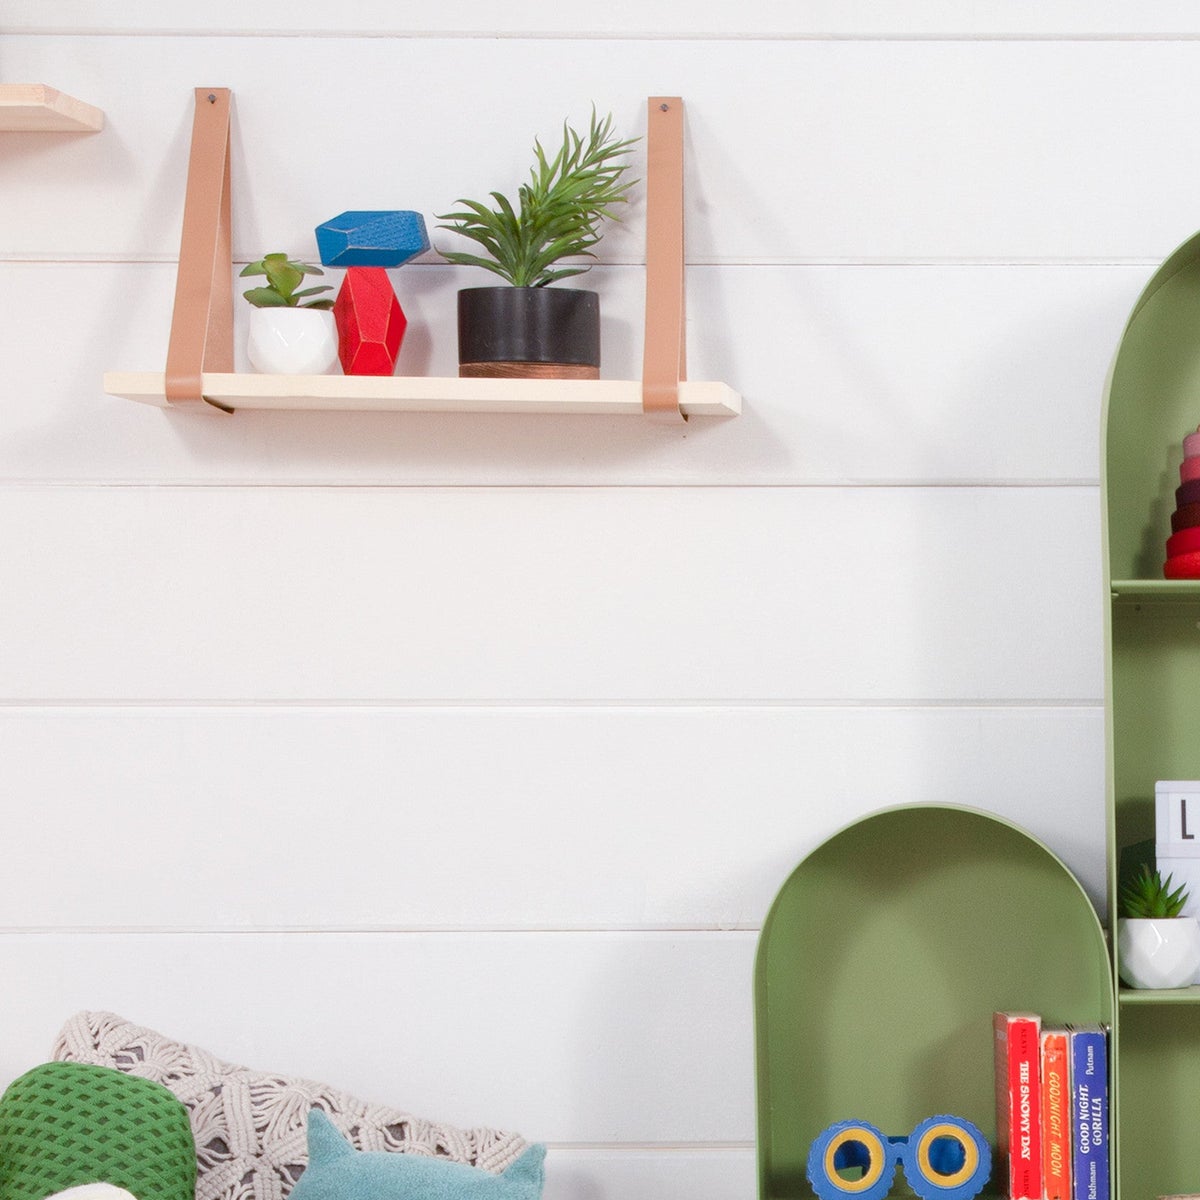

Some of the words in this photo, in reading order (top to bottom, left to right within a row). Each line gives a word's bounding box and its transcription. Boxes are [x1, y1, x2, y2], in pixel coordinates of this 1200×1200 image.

[1020, 1062, 1029, 1084] THE
[1085, 1046, 1094, 1075] Putnam
[1020, 1086, 1030, 1134] SNOWY
[1049, 1072, 1062, 1138] GOODNIGHT
[1091, 1098, 1103, 1145] GORILLA
[1021, 1136, 1031, 1160] DAY
[1080, 1123, 1089, 1153] GOOD
[1050, 1141, 1063, 1177] MOON
[1088, 1162, 1097, 1200] Rathmann
